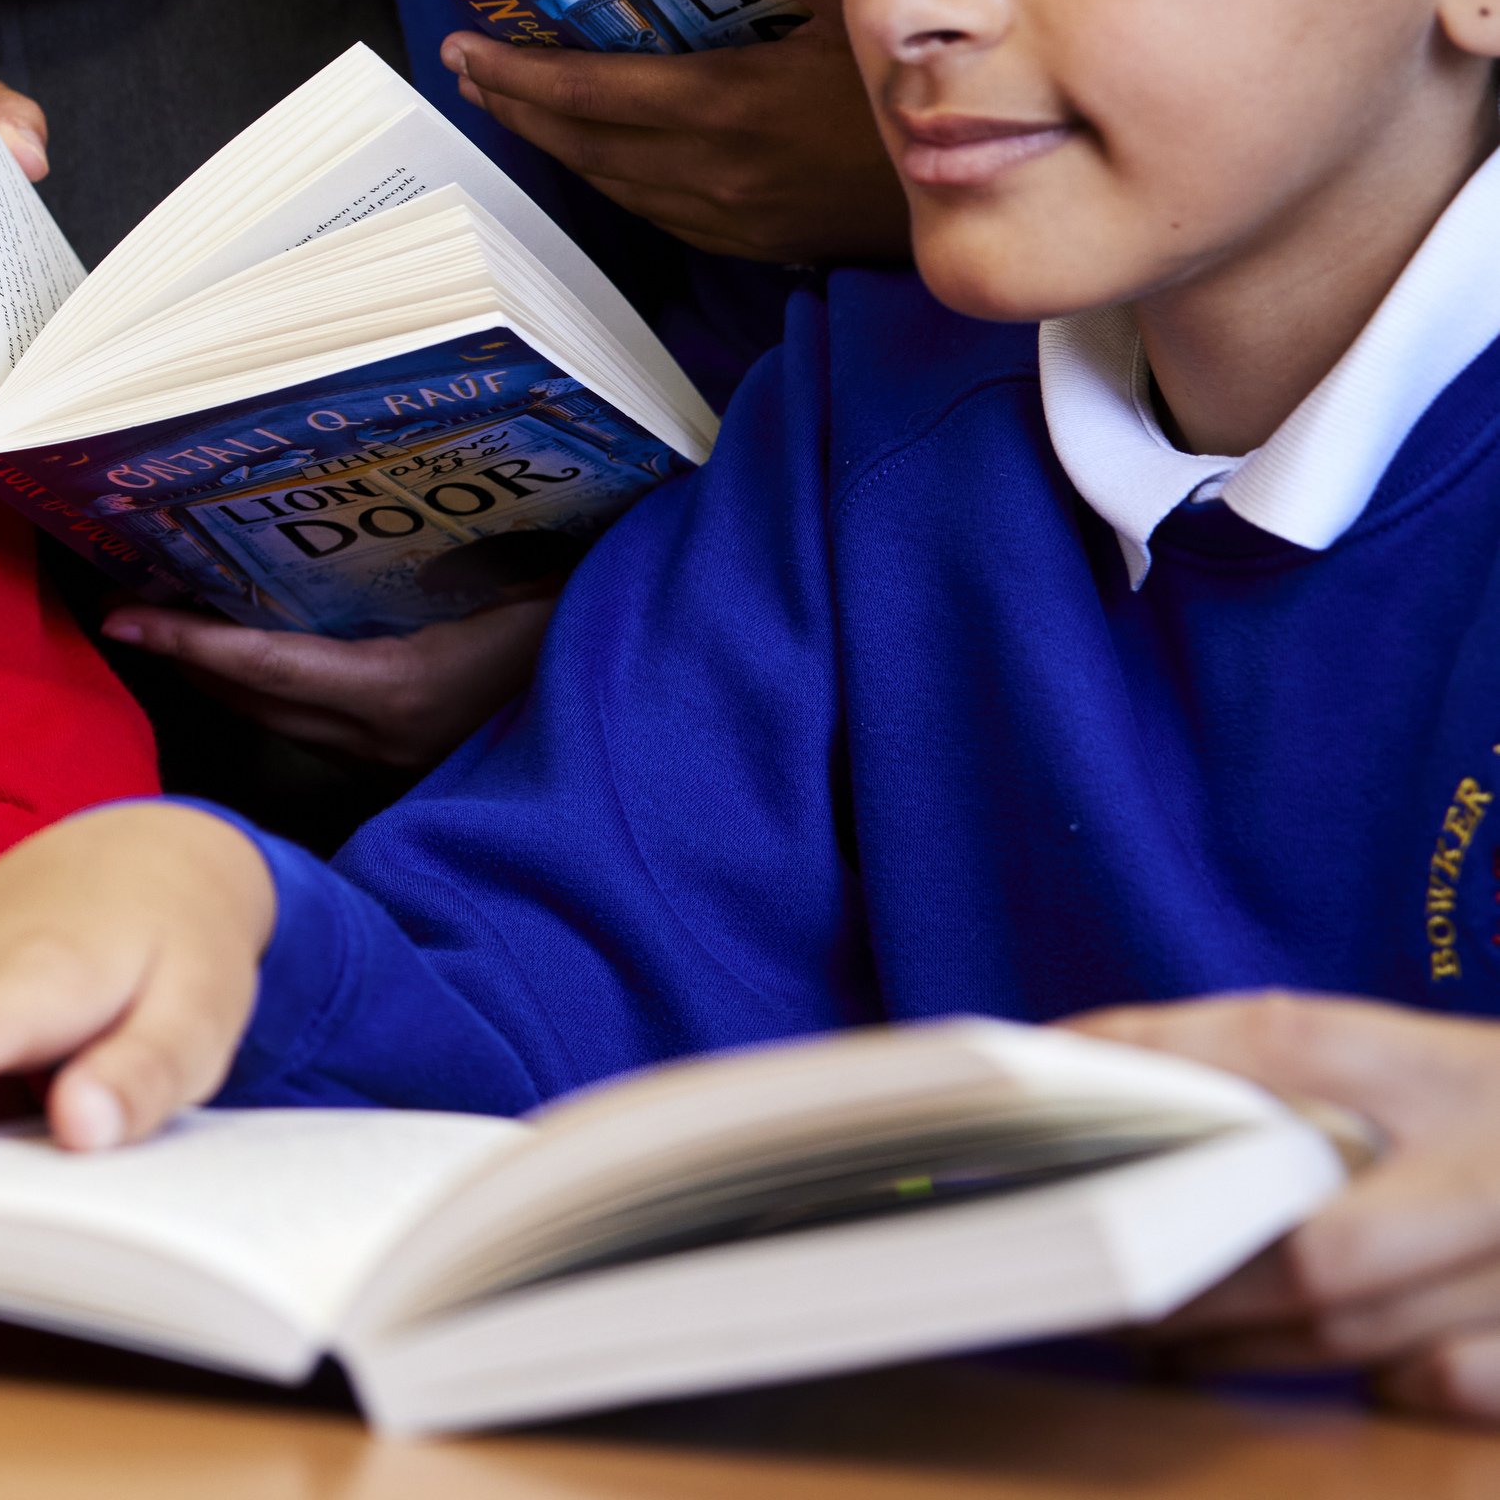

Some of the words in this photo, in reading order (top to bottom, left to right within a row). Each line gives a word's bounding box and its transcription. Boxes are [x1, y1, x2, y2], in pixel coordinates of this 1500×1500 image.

[316, 206, 351, 234] down
[352, 195, 368, 207] to
[369, 165, 407, 194] watch
[350, 203, 376, 225] had
[376, 174, 418, 206] people
[395, 184, 427, 206] mera
[1, 304, 11, 329] and
[7, 336, 15, 368] ideas
[218, 477, 384, 525] LION
[389, 430, 510, 477] above
[312, 447, 402, 476] THE
[275, 458, 583, 559] DOOR
[1426, 776, 1494, 980] BOWKER
